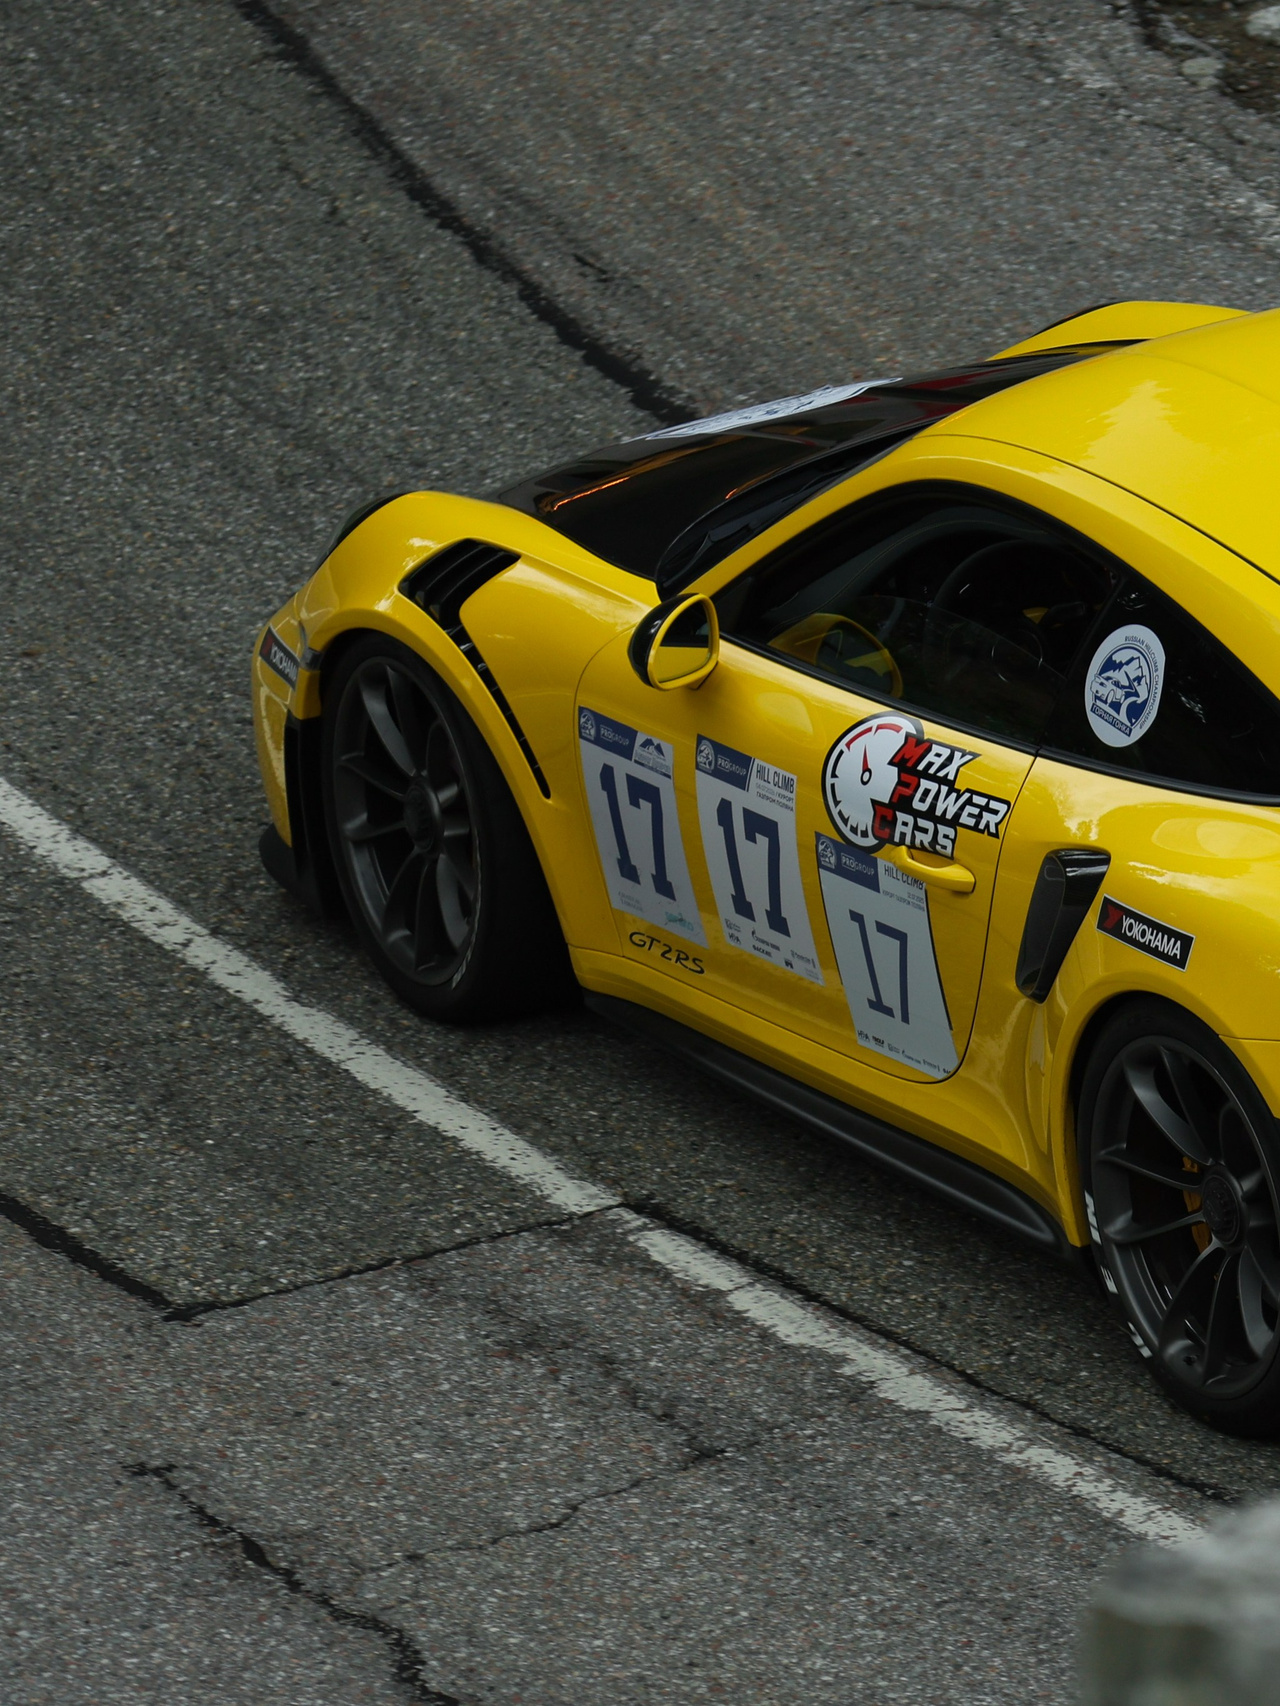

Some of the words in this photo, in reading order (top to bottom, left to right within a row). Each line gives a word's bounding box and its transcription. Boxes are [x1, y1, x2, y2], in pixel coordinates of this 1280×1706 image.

[1124, 635, 1145, 647] RUSSIAN
[1144, 642, 1159, 674] HILLCLIMB
[1091, 704, 1114, 724] ГОРНАЯ
[1112, 717, 1131, 735] ГОНКА
[1139, 674, 1159, 730] CHAMPIONSHIP
[717, 757, 748, 777] PROGROUP
[756, 763, 771, 785] HILL
[773, 770, 795, 794] CLIMB
[892, 735, 975, 781] MAX
[892, 772, 1008, 834] POWER
[599, 762, 678, 902] 17
[873, 804, 956, 858] CARS
[716, 796, 792, 939] 17
[841, 855, 875, 876] PROGROUP
[884, 863, 901, 882] HILL
[1121, 914, 1181, 960] YOKOHAMA
[849, 908, 911, 1026] 17
